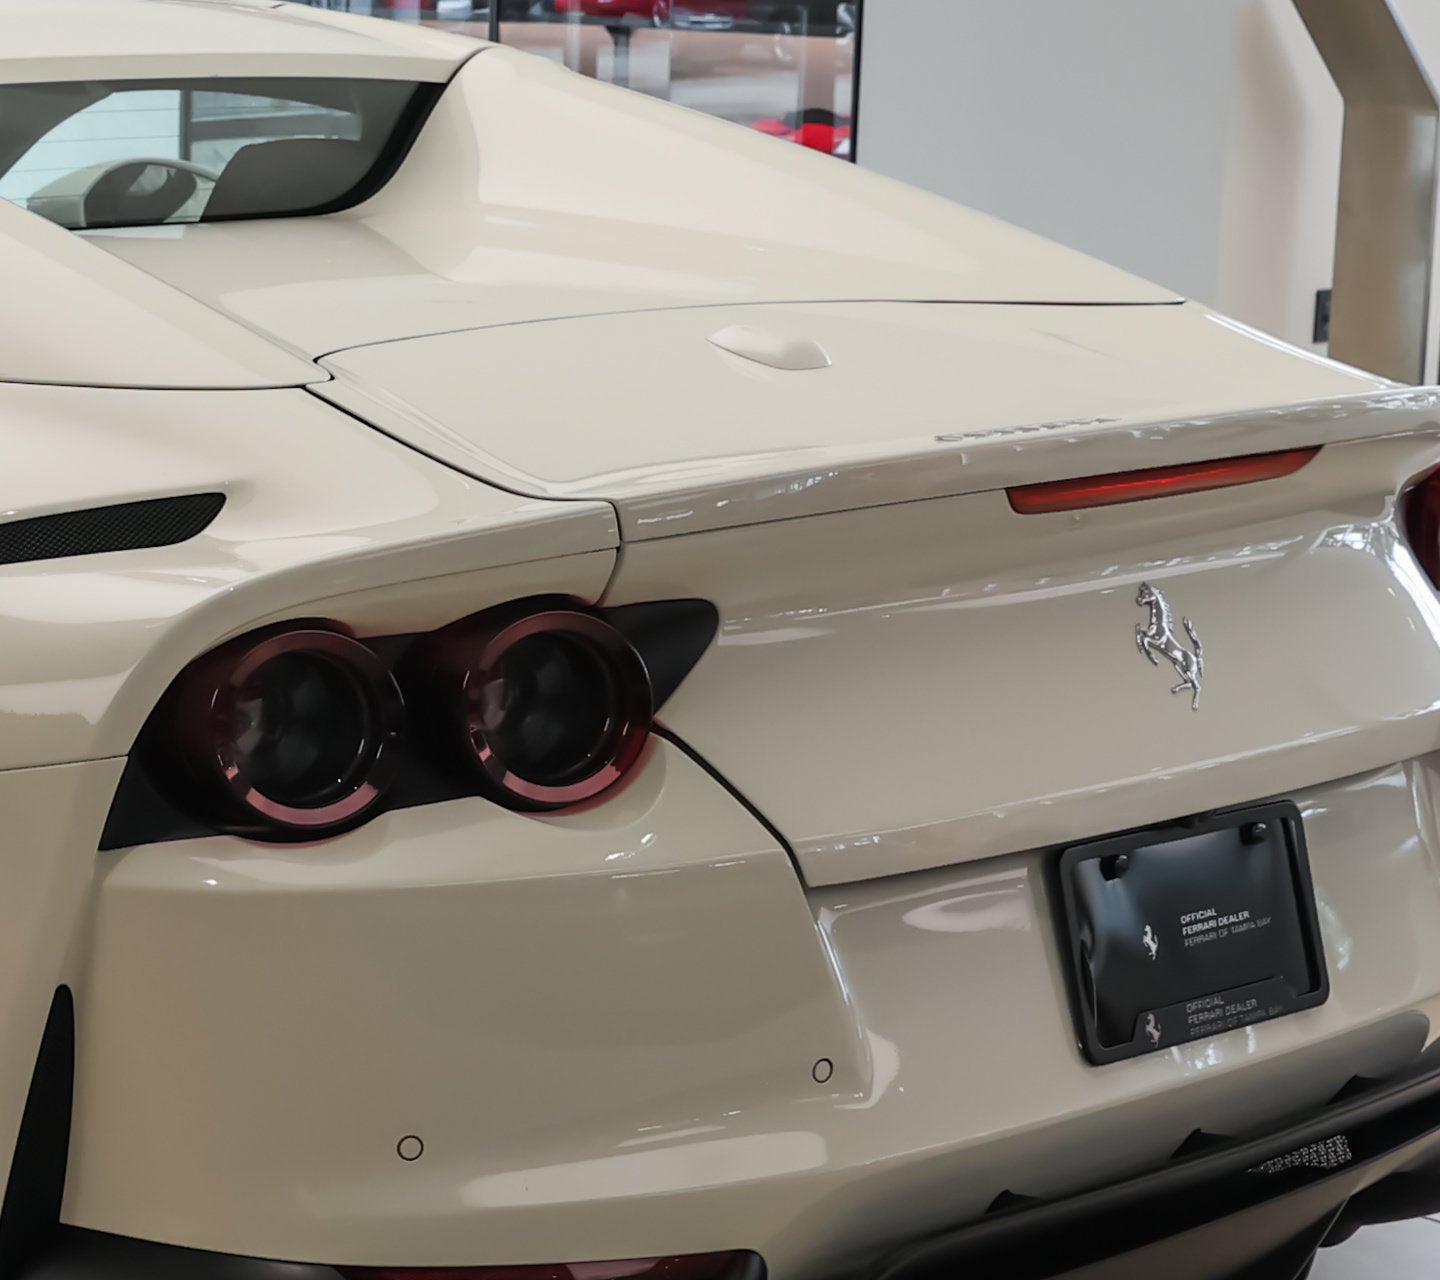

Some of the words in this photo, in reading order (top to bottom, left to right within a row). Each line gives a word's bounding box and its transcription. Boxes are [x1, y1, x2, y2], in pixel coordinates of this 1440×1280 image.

[1180, 908, 1217, 924] OFFICIAL
[1182, 920, 1217, 936] FERRARI
[1218, 911, 1250, 926] DEALER
[1185, 932, 1217, 947] FERRARI
[1218, 928, 1228, 938] OF
[1231, 921, 1256, 934] TAMPA
[1256, 917, 1272, 927] BAY
[1186, 996, 1224, 1013] OFFICIAL
[1188, 1008, 1223, 1024] FERRARI
[1225, 999, 1257, 1016] DEALER
